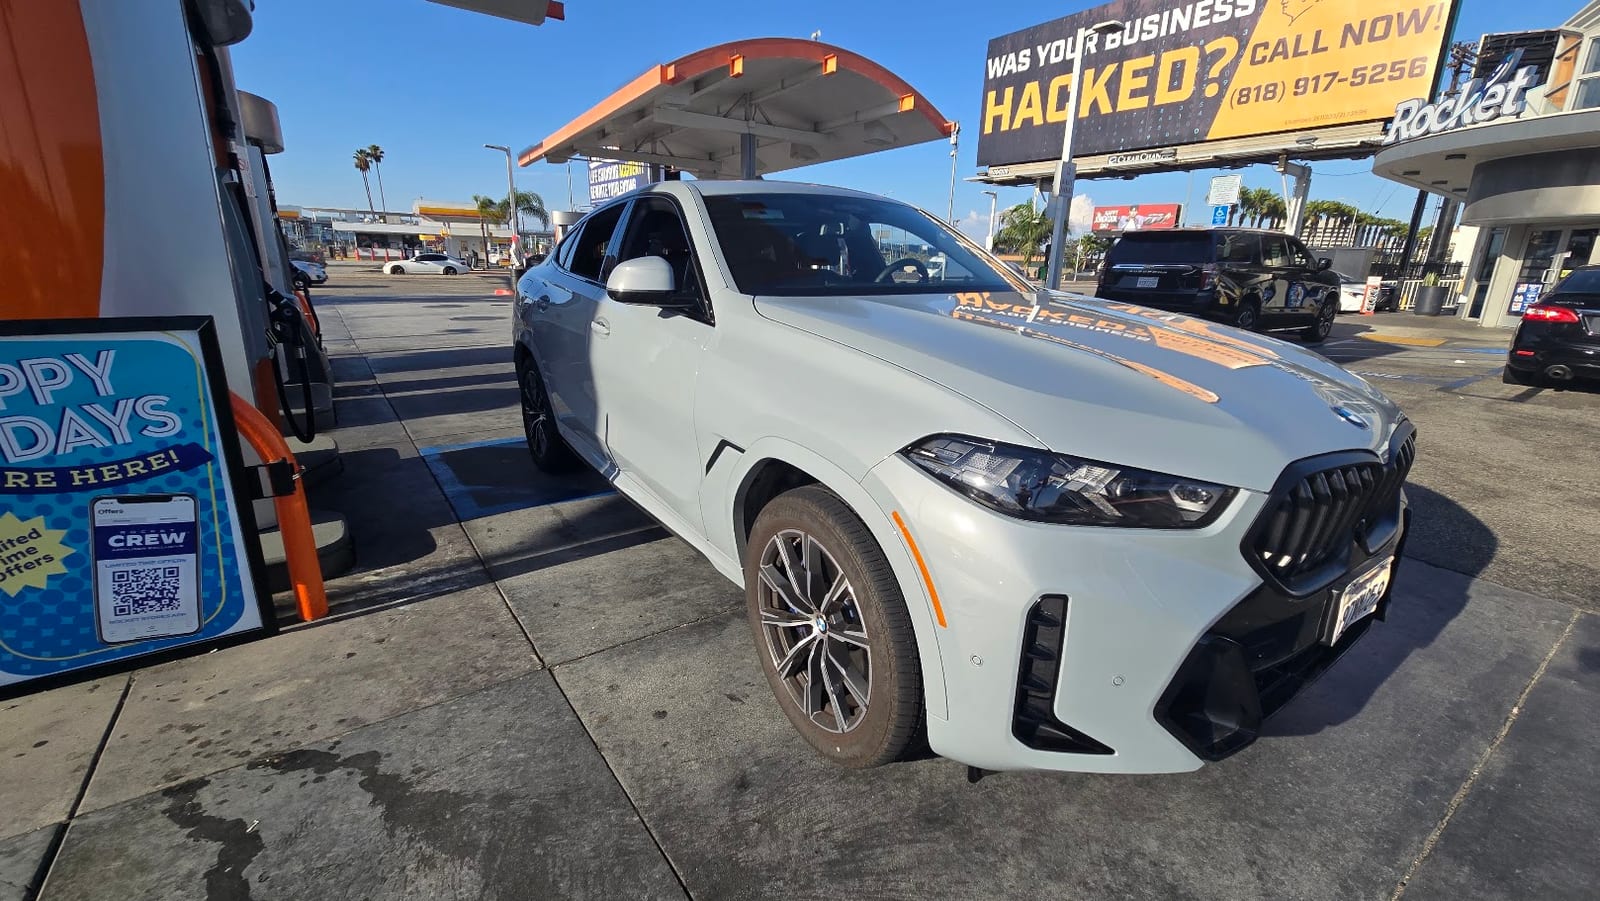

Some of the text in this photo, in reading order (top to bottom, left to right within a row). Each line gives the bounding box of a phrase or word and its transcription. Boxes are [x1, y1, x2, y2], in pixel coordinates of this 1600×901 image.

[987, 48, 1031, 80] WAS
[1105, 0, 1257, 50] BUSINESS
[1249, 2, 1446, 66] CALL NOW!
[983, 35, 1240, 135] HACKED?
[1229, 56, 1429, 109] (818) 917-5256
[1384, 63, 1539, 145] Rocket
[0, 395, 183, 463] DAYS
[4, 449, 180, 488] RE HERE!
[0, 528, 42, 552] ited
[108, 532, 186, 548] CREW
